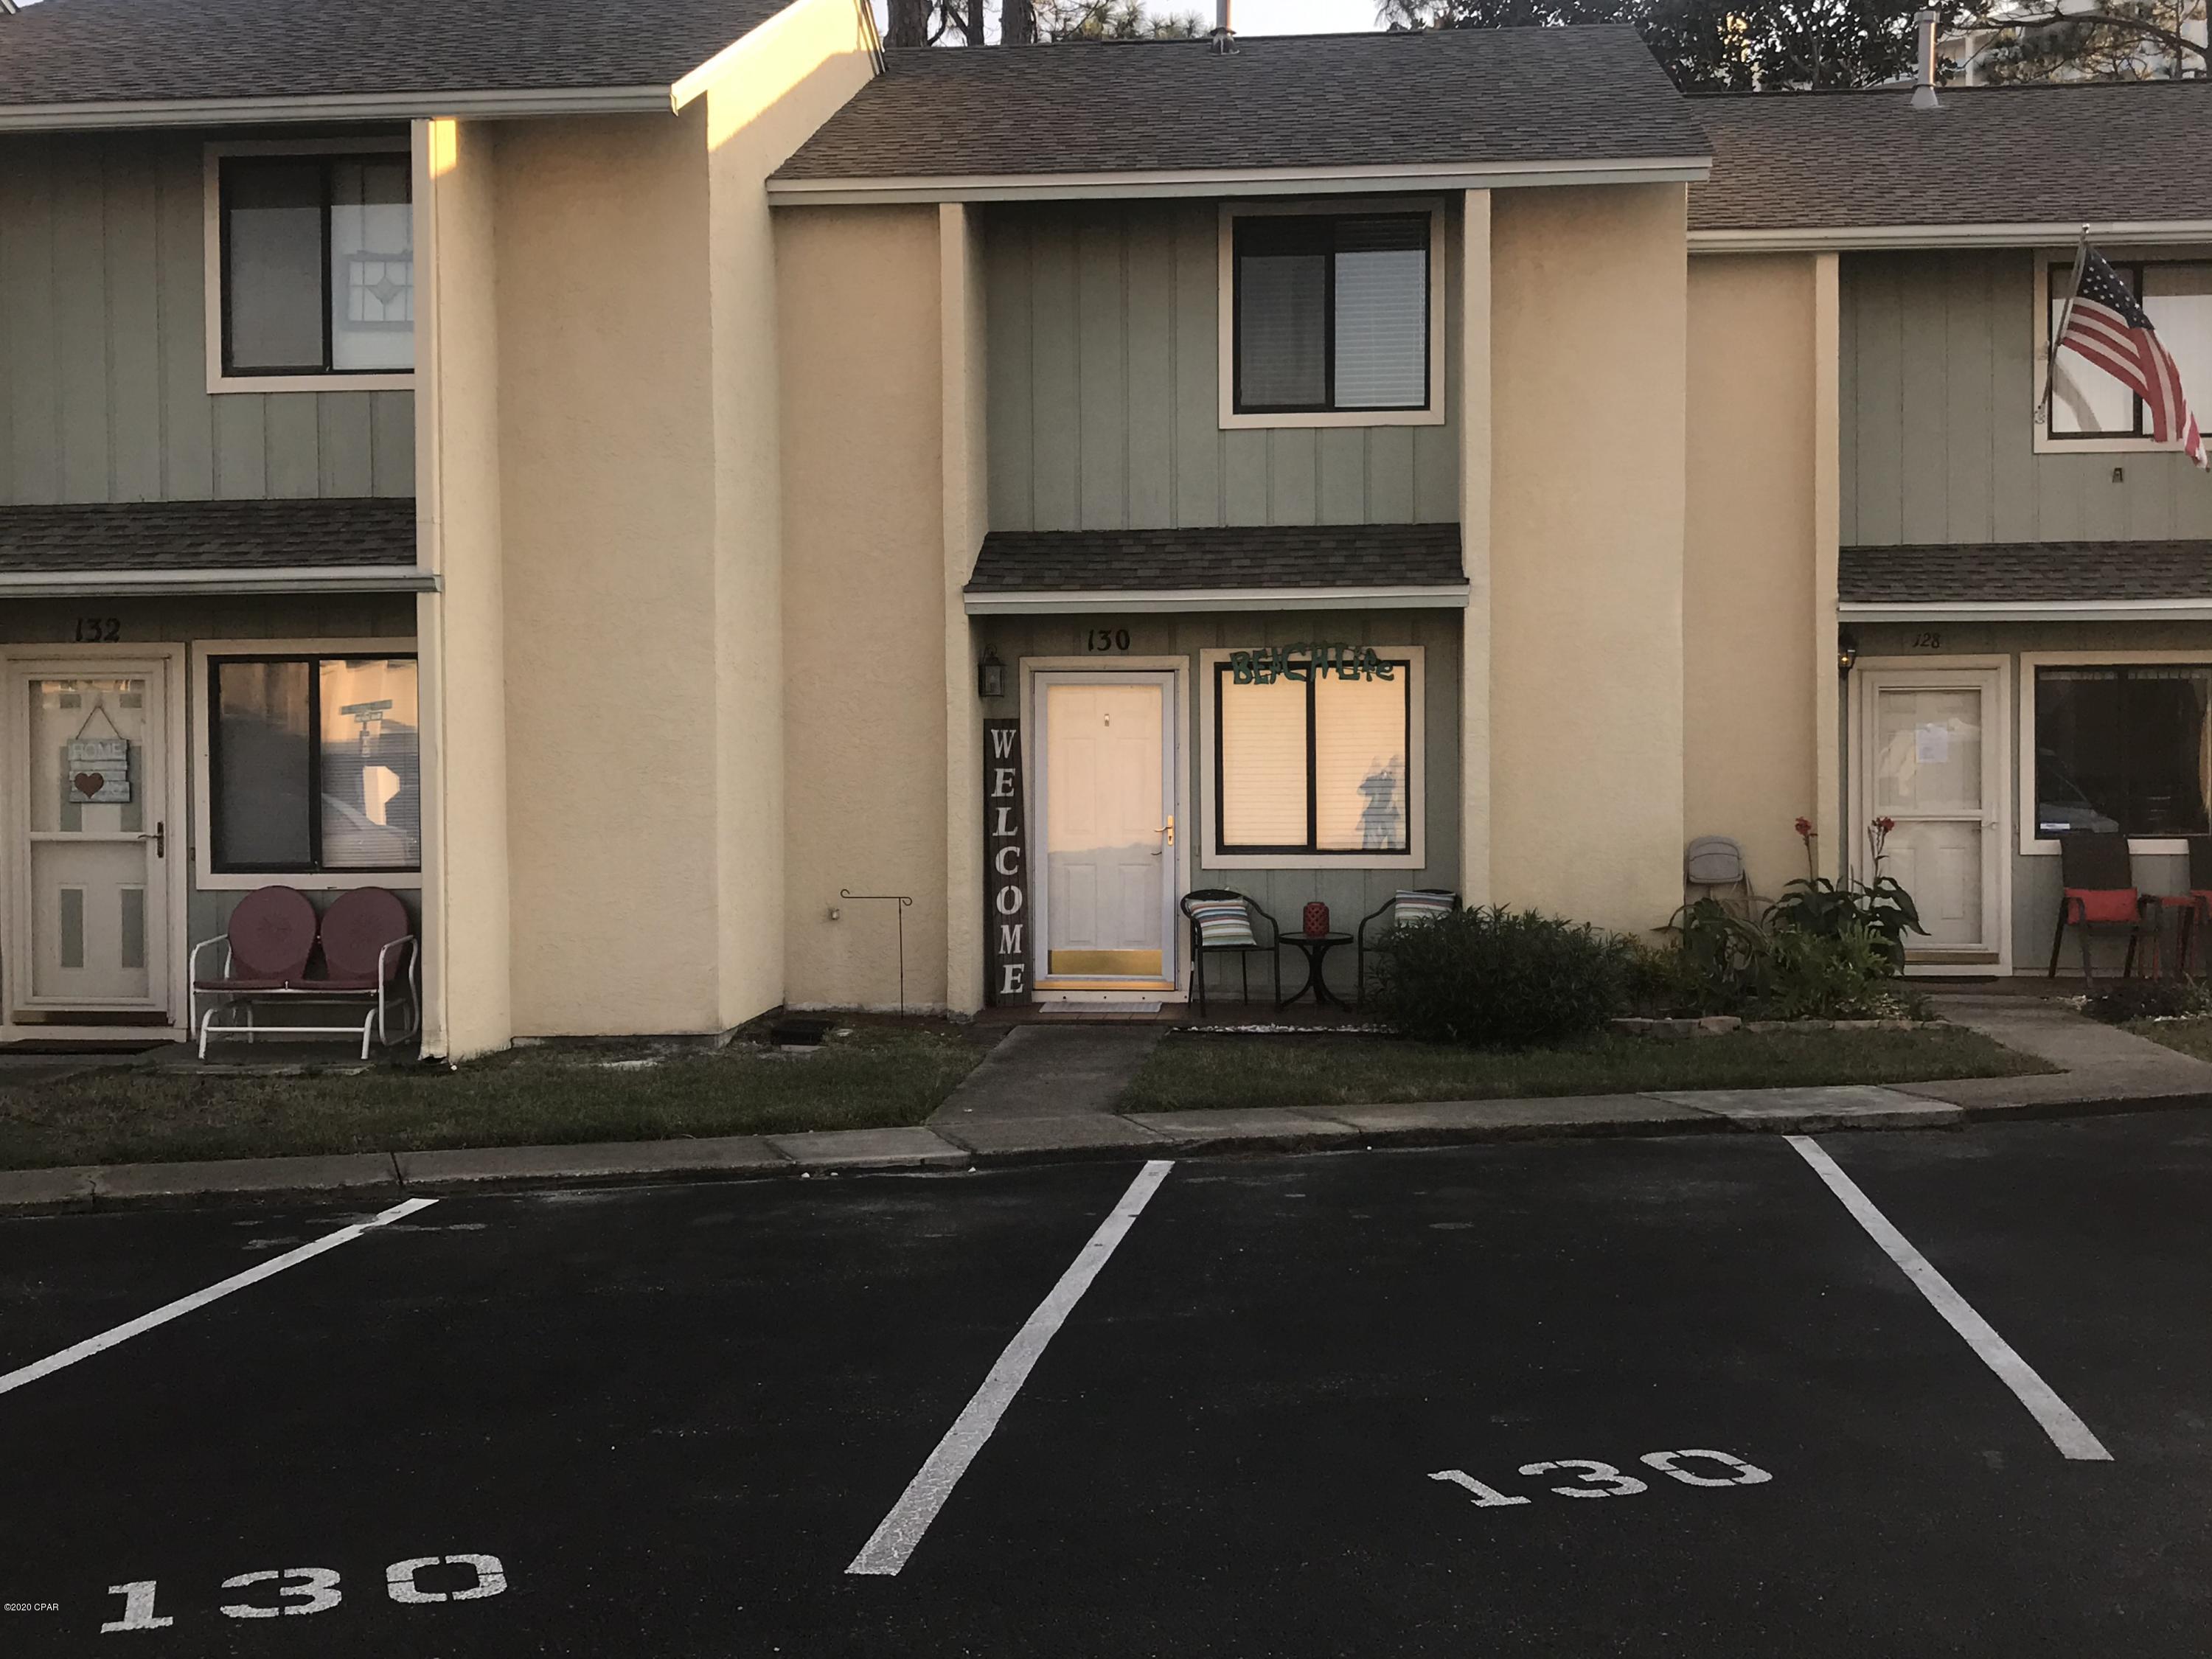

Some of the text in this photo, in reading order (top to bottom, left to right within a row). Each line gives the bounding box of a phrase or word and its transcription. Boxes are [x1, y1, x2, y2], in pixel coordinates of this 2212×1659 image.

[76, 617, 120, 643] 132
[1088, 629, 1130, 652] 130
[1912, 633, 1940, 648] 128
[991, 728, 1025, 994] WELCOME
[1427, 1449, 1773, 1508] 130
[100, 1554, 507, 1633] 130
